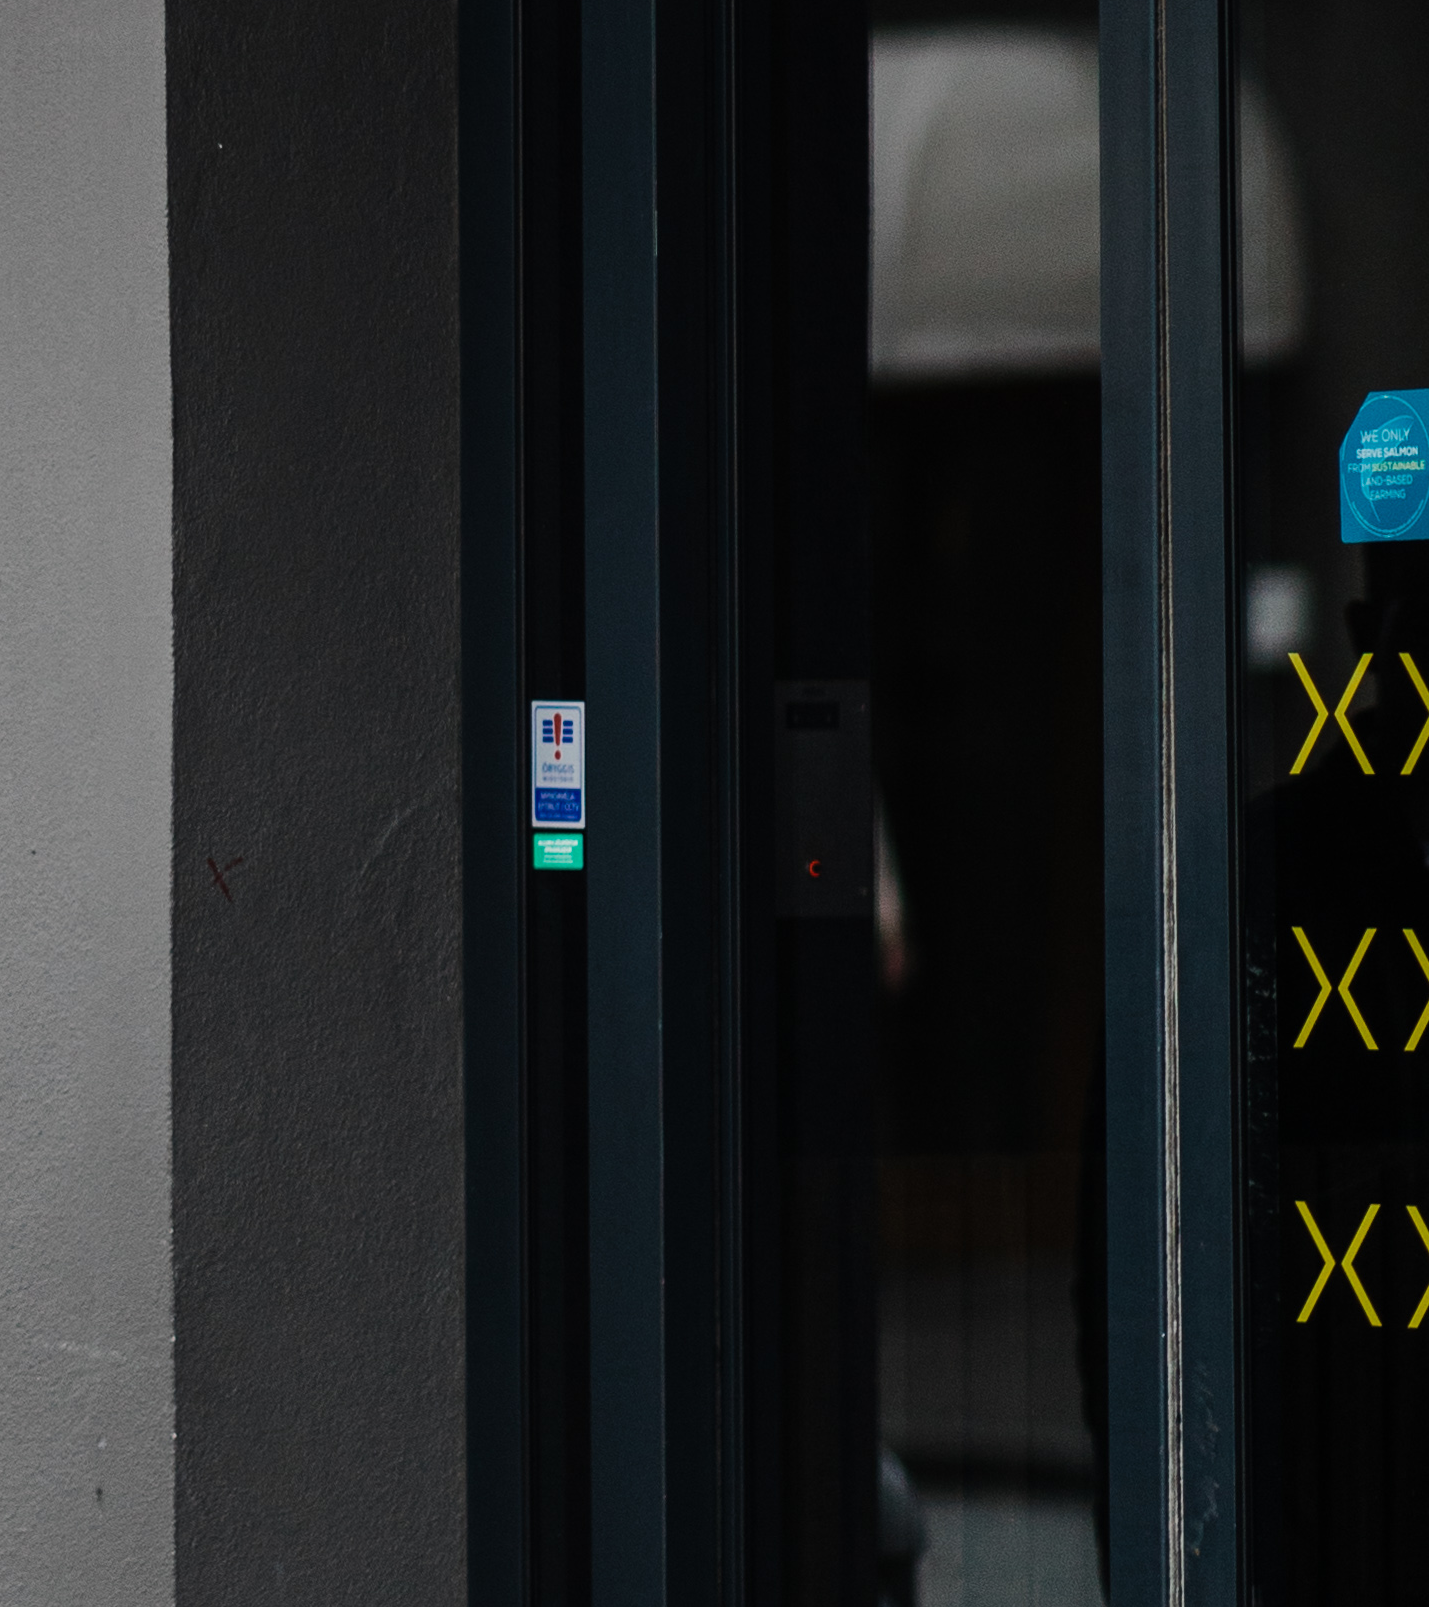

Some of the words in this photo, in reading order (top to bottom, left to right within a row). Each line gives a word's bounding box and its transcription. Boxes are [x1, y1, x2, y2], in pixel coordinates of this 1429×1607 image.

[1360, 429, 1378, 443] WE
[1382, 428, 1410, 442] ONLY
[1356, 448, 1382, 460] SERVE
[1384, 446, 1419, 458] SALMON
[1348, 464, 1371, 473] FROM
[1372, 460, 1426, 472] SUSTAINABLE
[1370, 489, 1406, 500] FARMING
